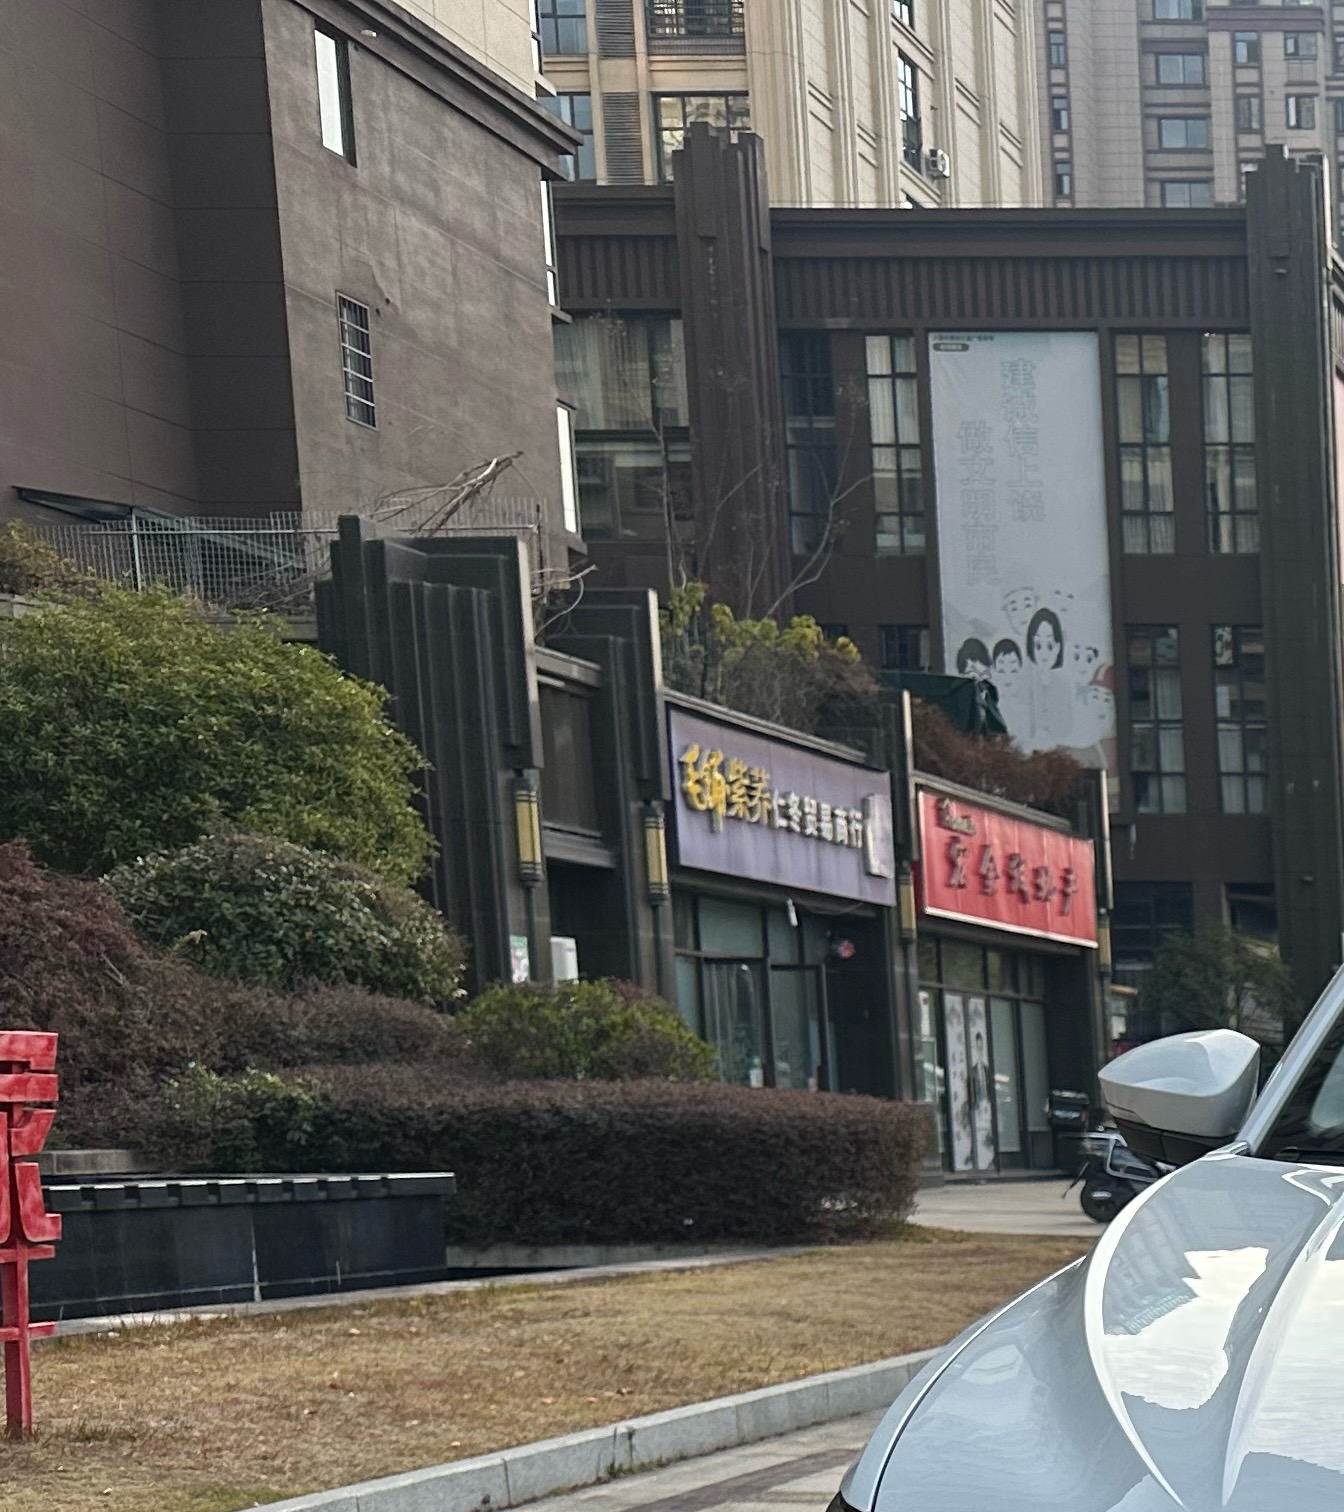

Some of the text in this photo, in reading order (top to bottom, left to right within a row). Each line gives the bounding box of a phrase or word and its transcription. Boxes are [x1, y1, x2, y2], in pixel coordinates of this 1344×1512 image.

[957, 421, 1000, 587] 做文明市民
